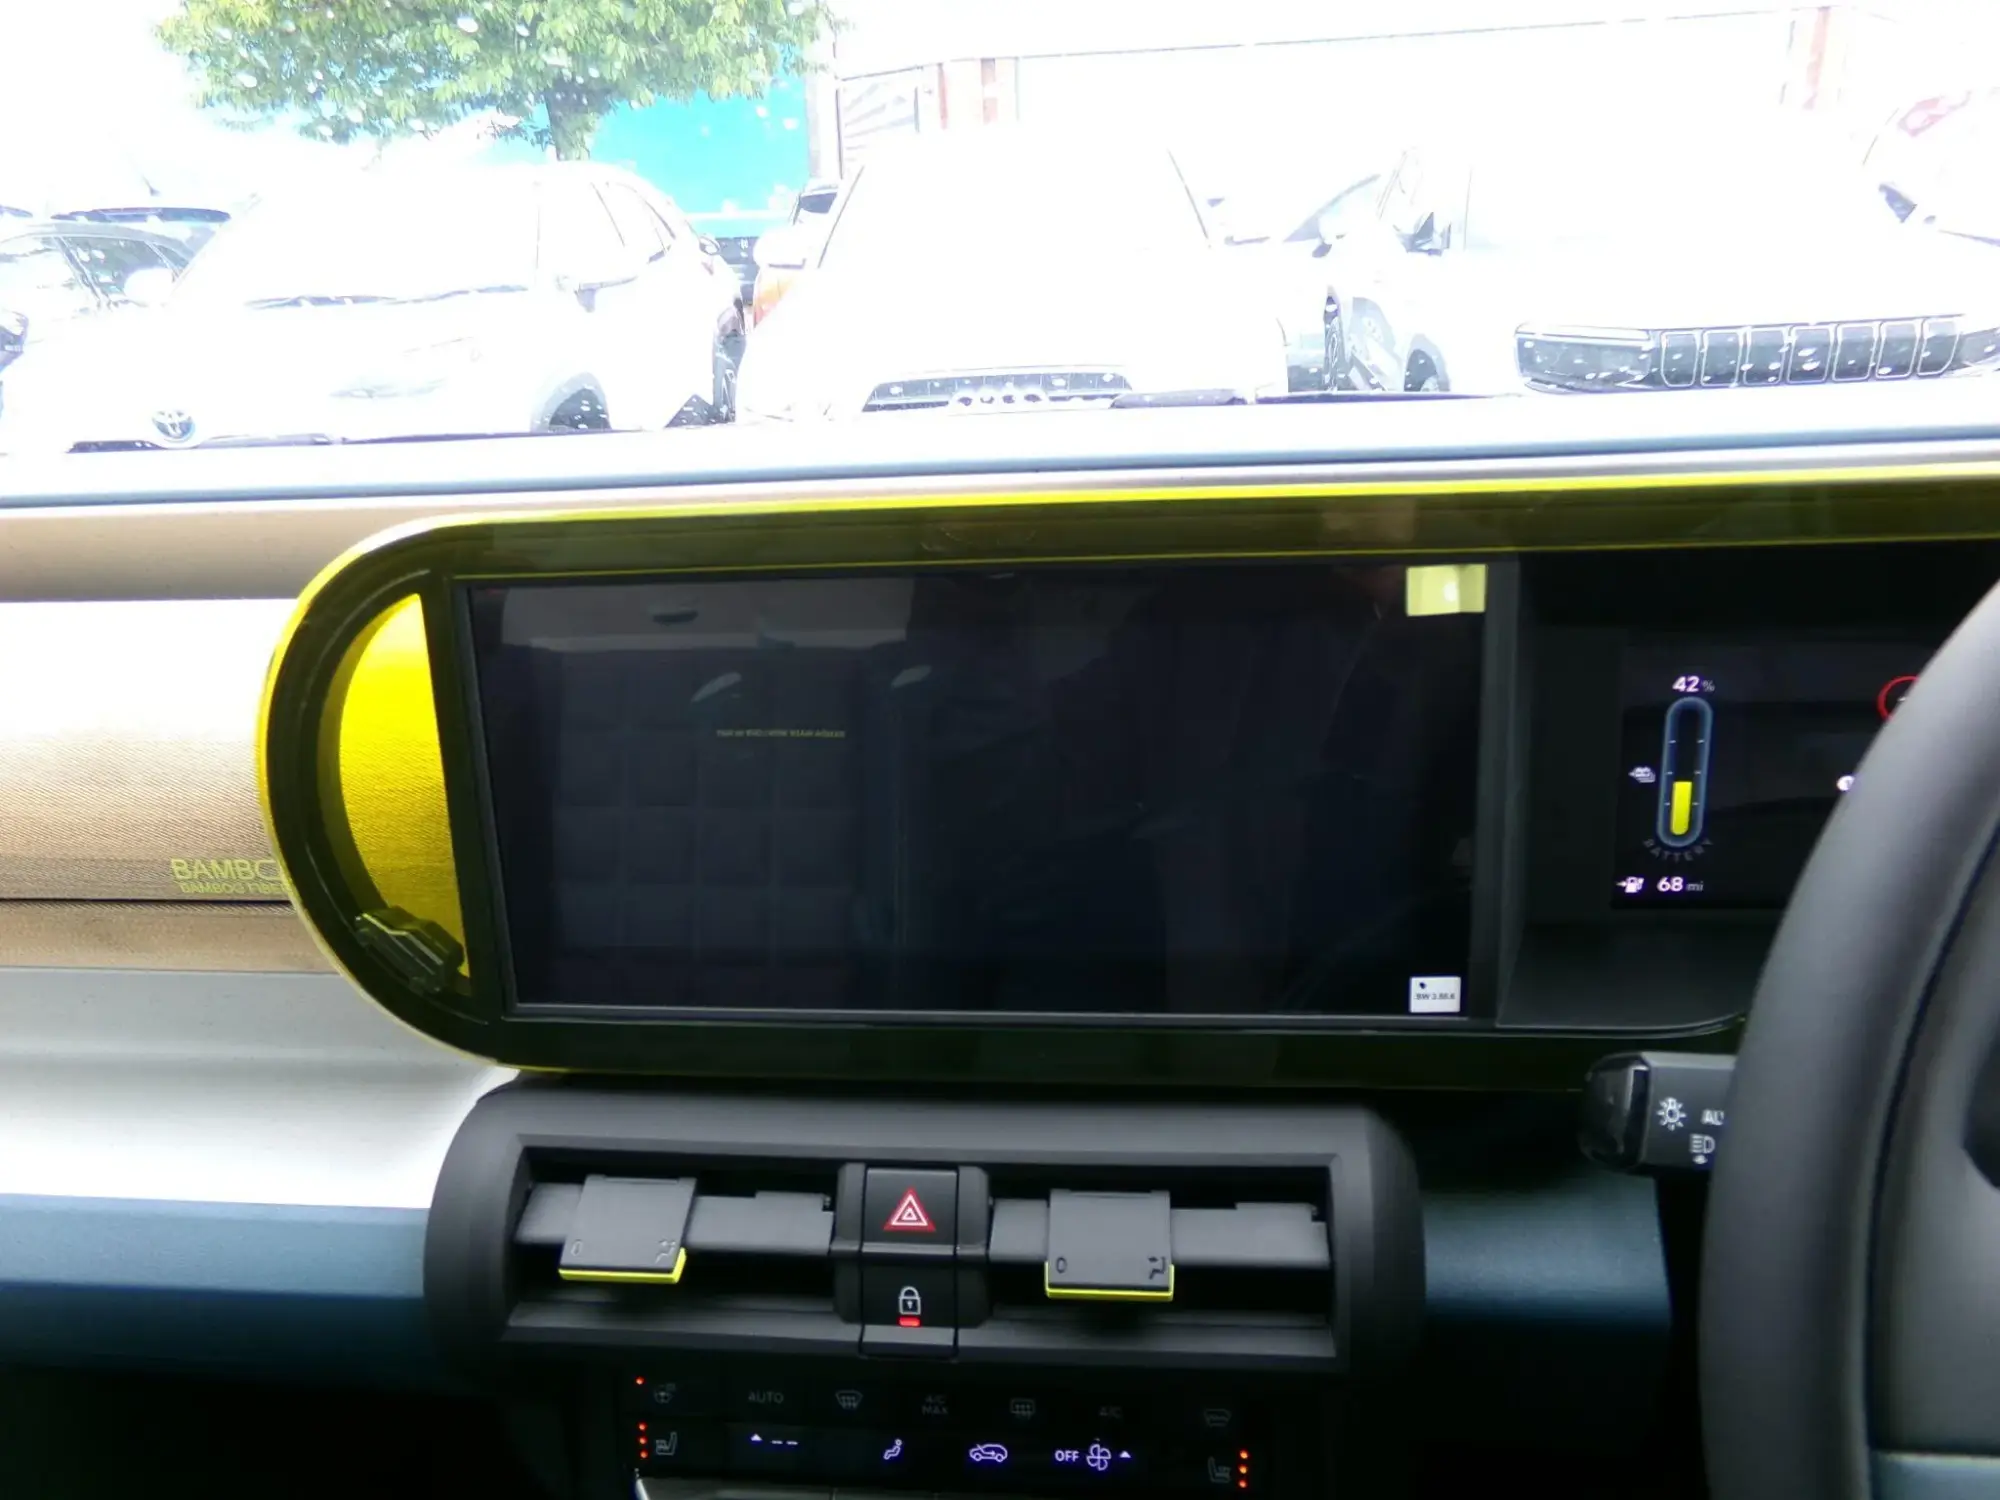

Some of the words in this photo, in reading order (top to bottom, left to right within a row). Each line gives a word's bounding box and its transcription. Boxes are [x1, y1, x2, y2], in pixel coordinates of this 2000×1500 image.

[1656, 876, 1685, 892] 68
[1686, 880, 1704, 892] mi
[747, 1391, 784, 1404] AUTO
[921, 1405, 949, 1415] MAX
[1055, 1449, 1080, 1463] OFF
